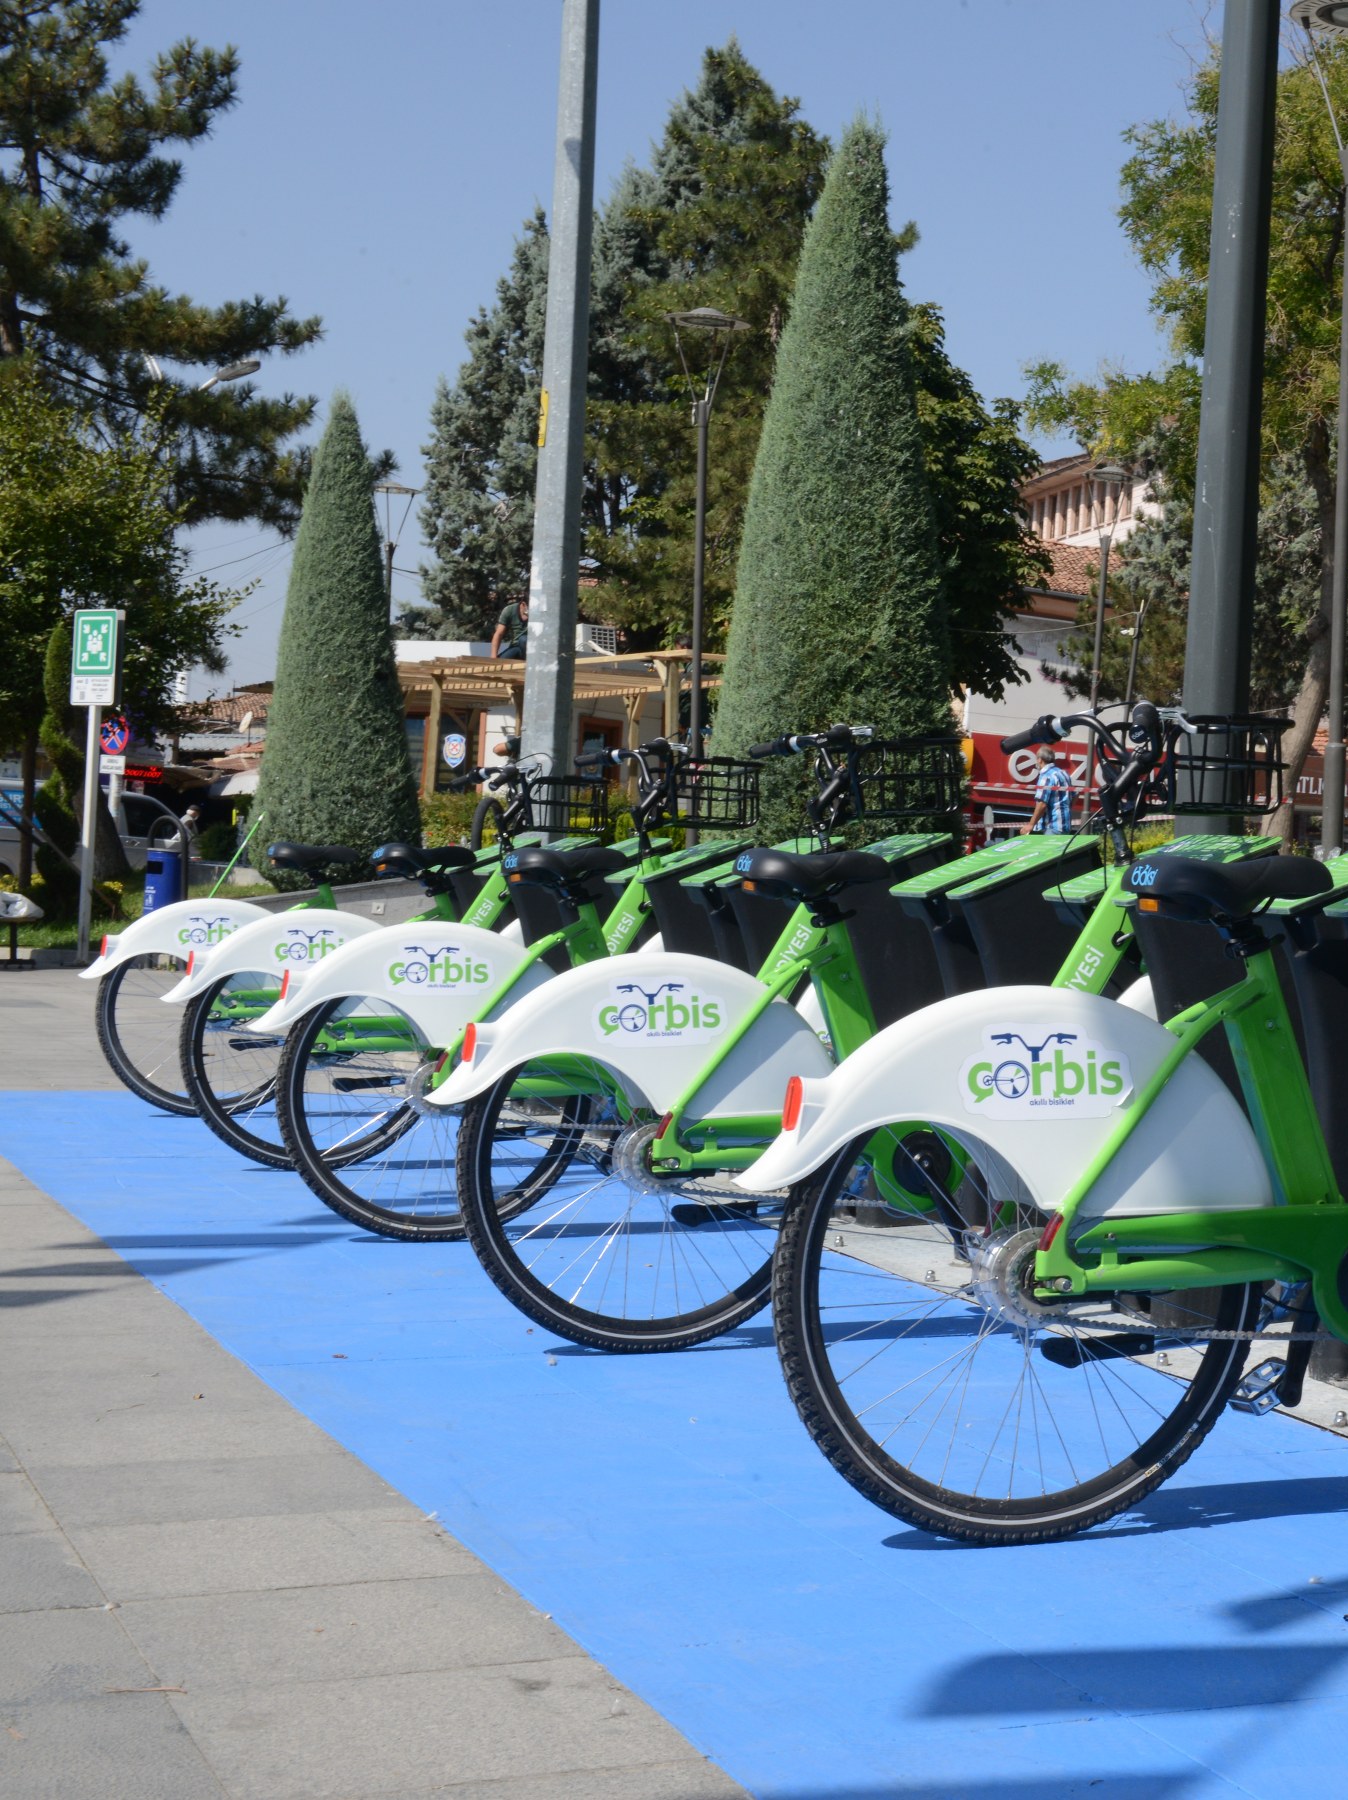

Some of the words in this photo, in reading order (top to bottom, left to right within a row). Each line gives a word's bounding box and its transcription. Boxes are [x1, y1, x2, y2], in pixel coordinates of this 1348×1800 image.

[1296, 776, 1324, 795] TLI
[178, 924, 238, 945] çorb
[967, 1049, 1124, 1104] çorbis
